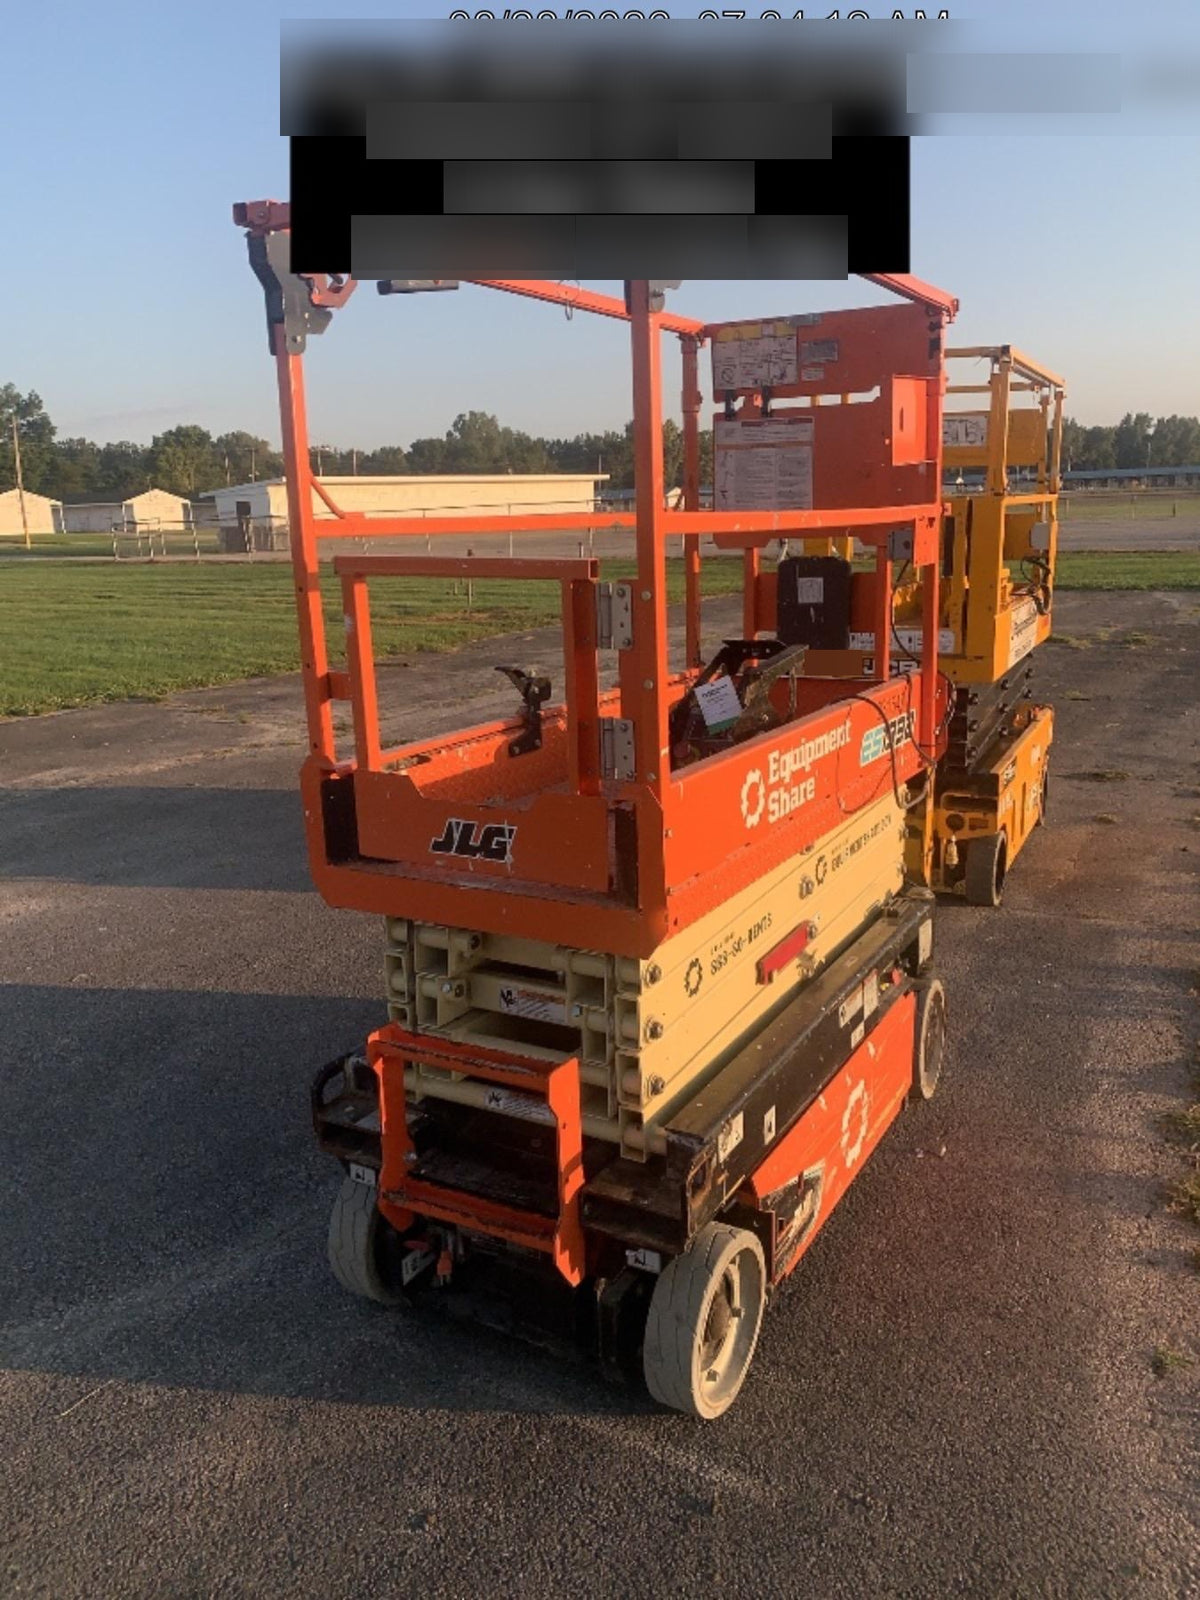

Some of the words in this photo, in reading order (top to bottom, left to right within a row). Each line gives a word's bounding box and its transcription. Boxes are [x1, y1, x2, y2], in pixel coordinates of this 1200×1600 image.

[768, 720, 851, 783] Equipment
[768, 777, 815, 823] Share
[429, 818, 517, 864] JLG
